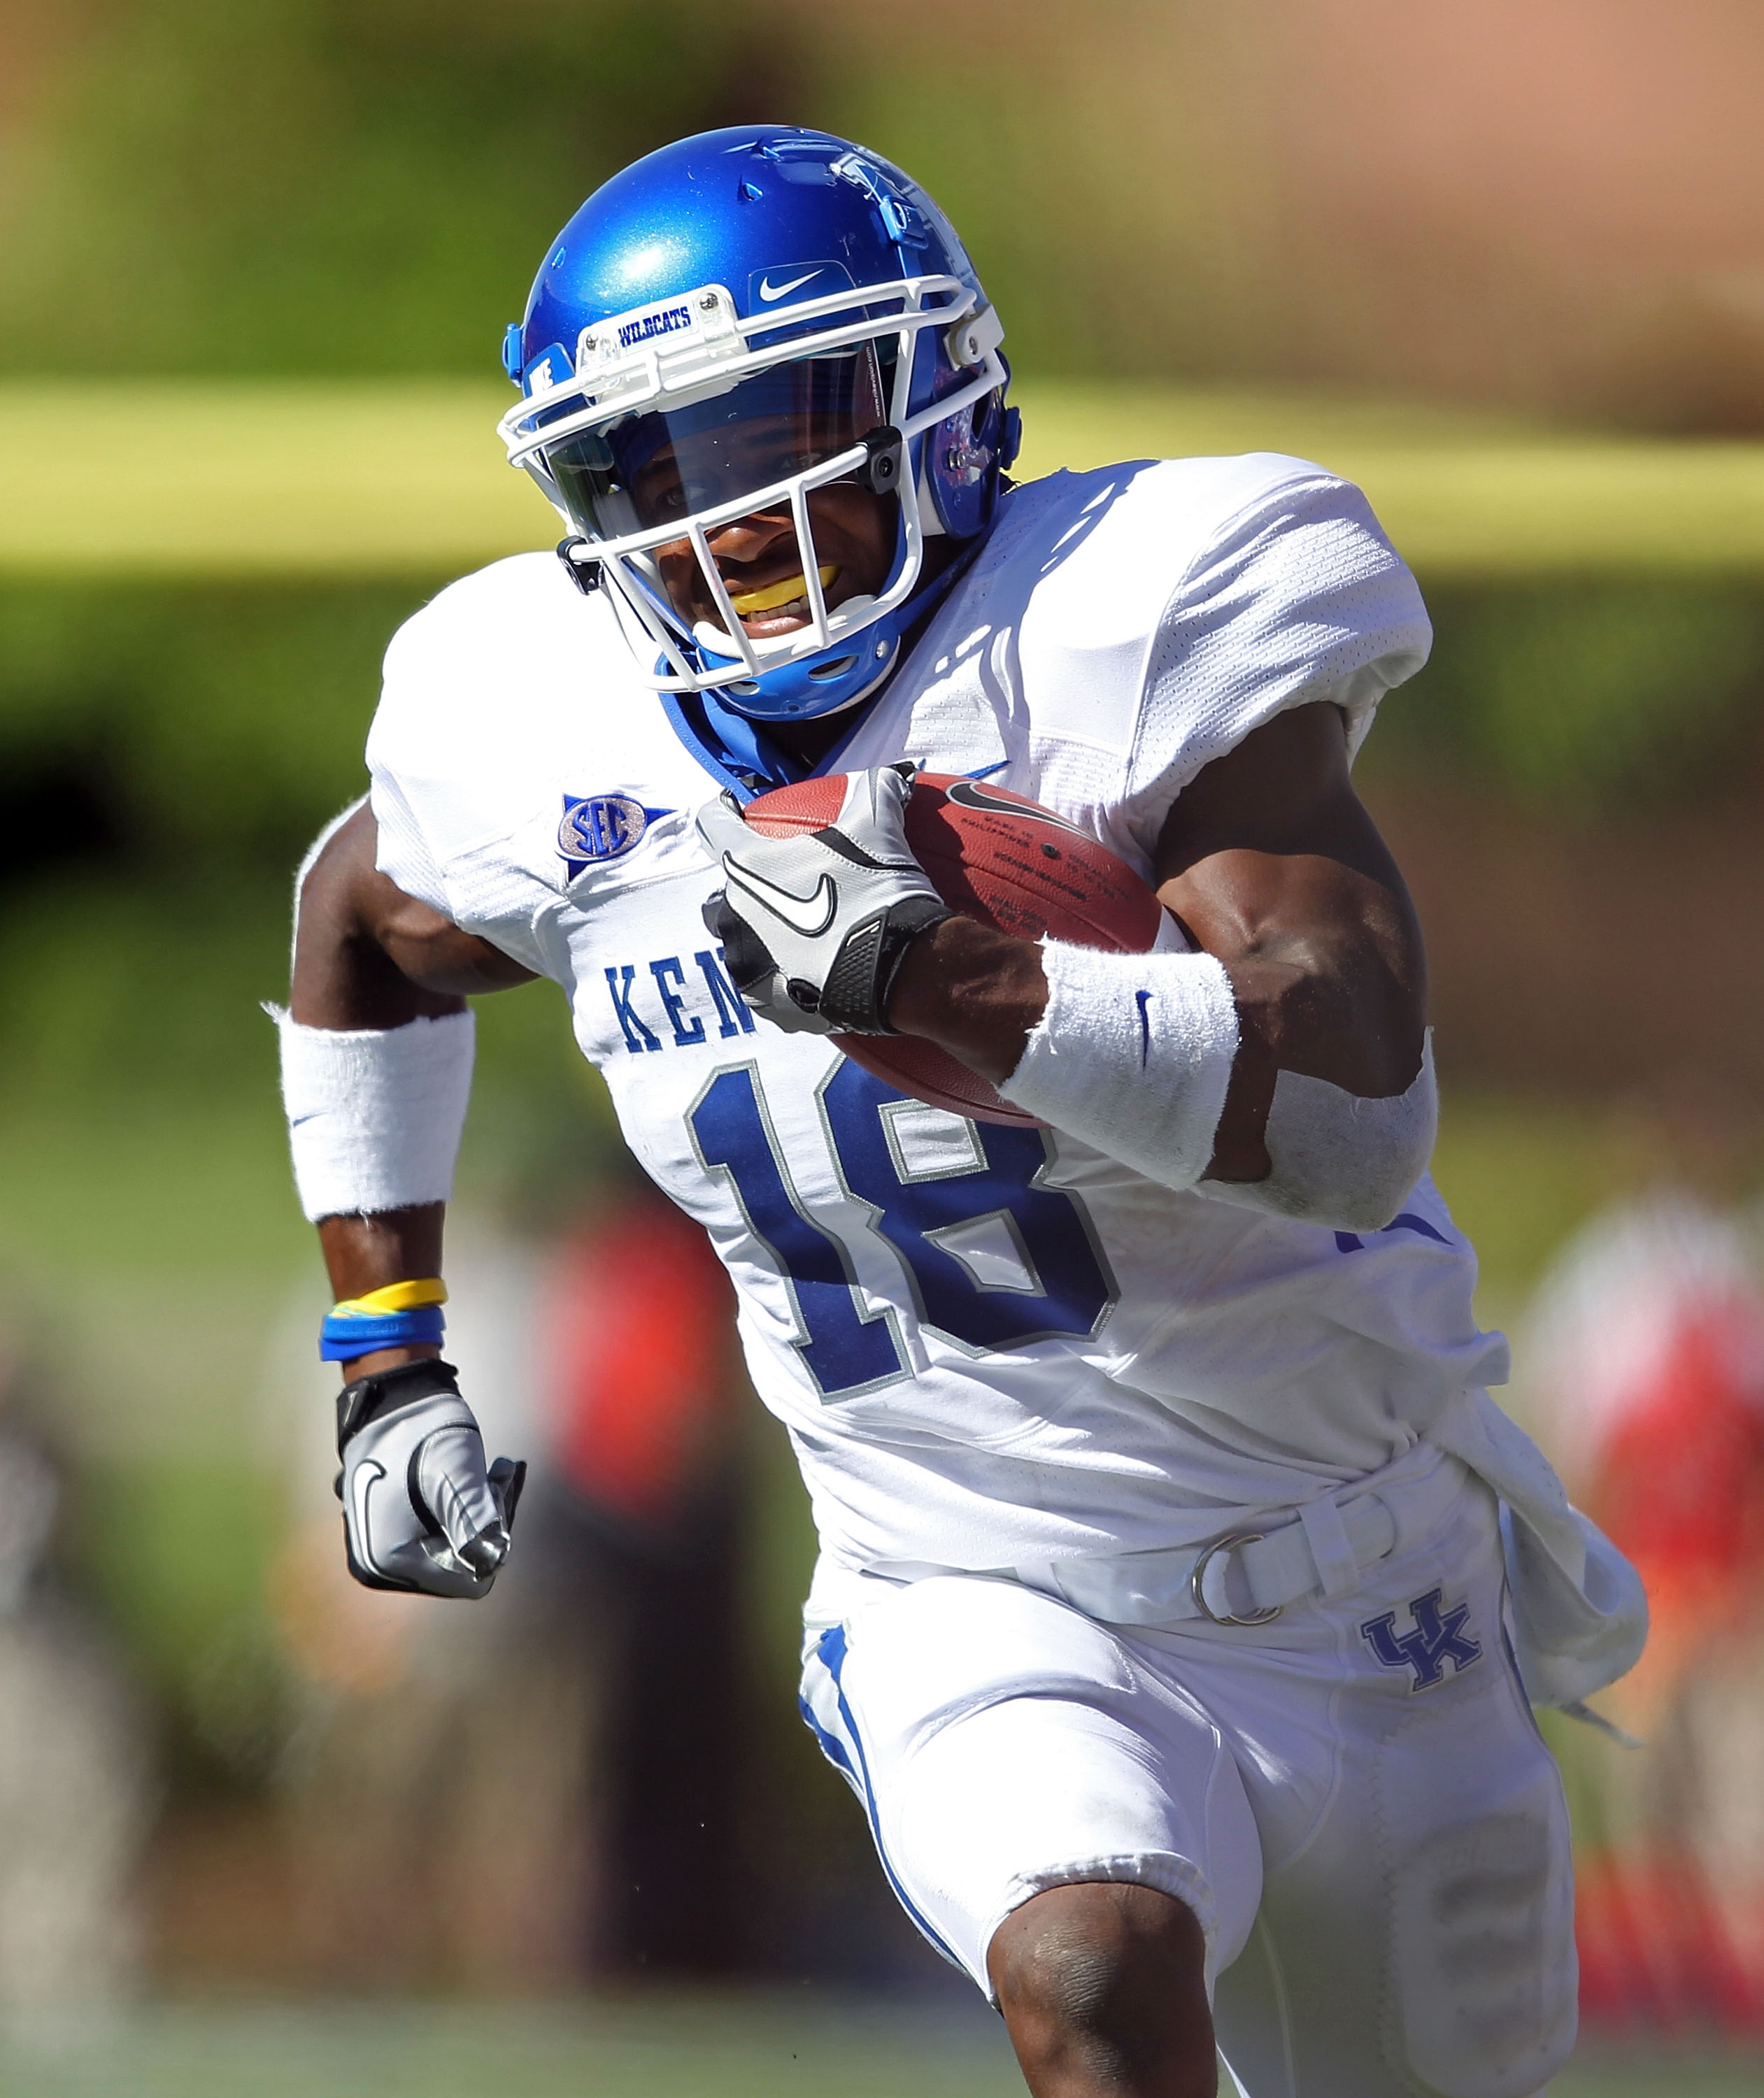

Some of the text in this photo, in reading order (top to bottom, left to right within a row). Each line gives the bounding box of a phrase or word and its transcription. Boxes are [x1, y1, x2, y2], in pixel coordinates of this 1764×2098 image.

[618, 306, 692, 348] WILDCATS
[571, 802, 627, 855] SEC
[683, 1052, 1121, 1405] 18
[1360, 1587, 1483, 1692] UK
